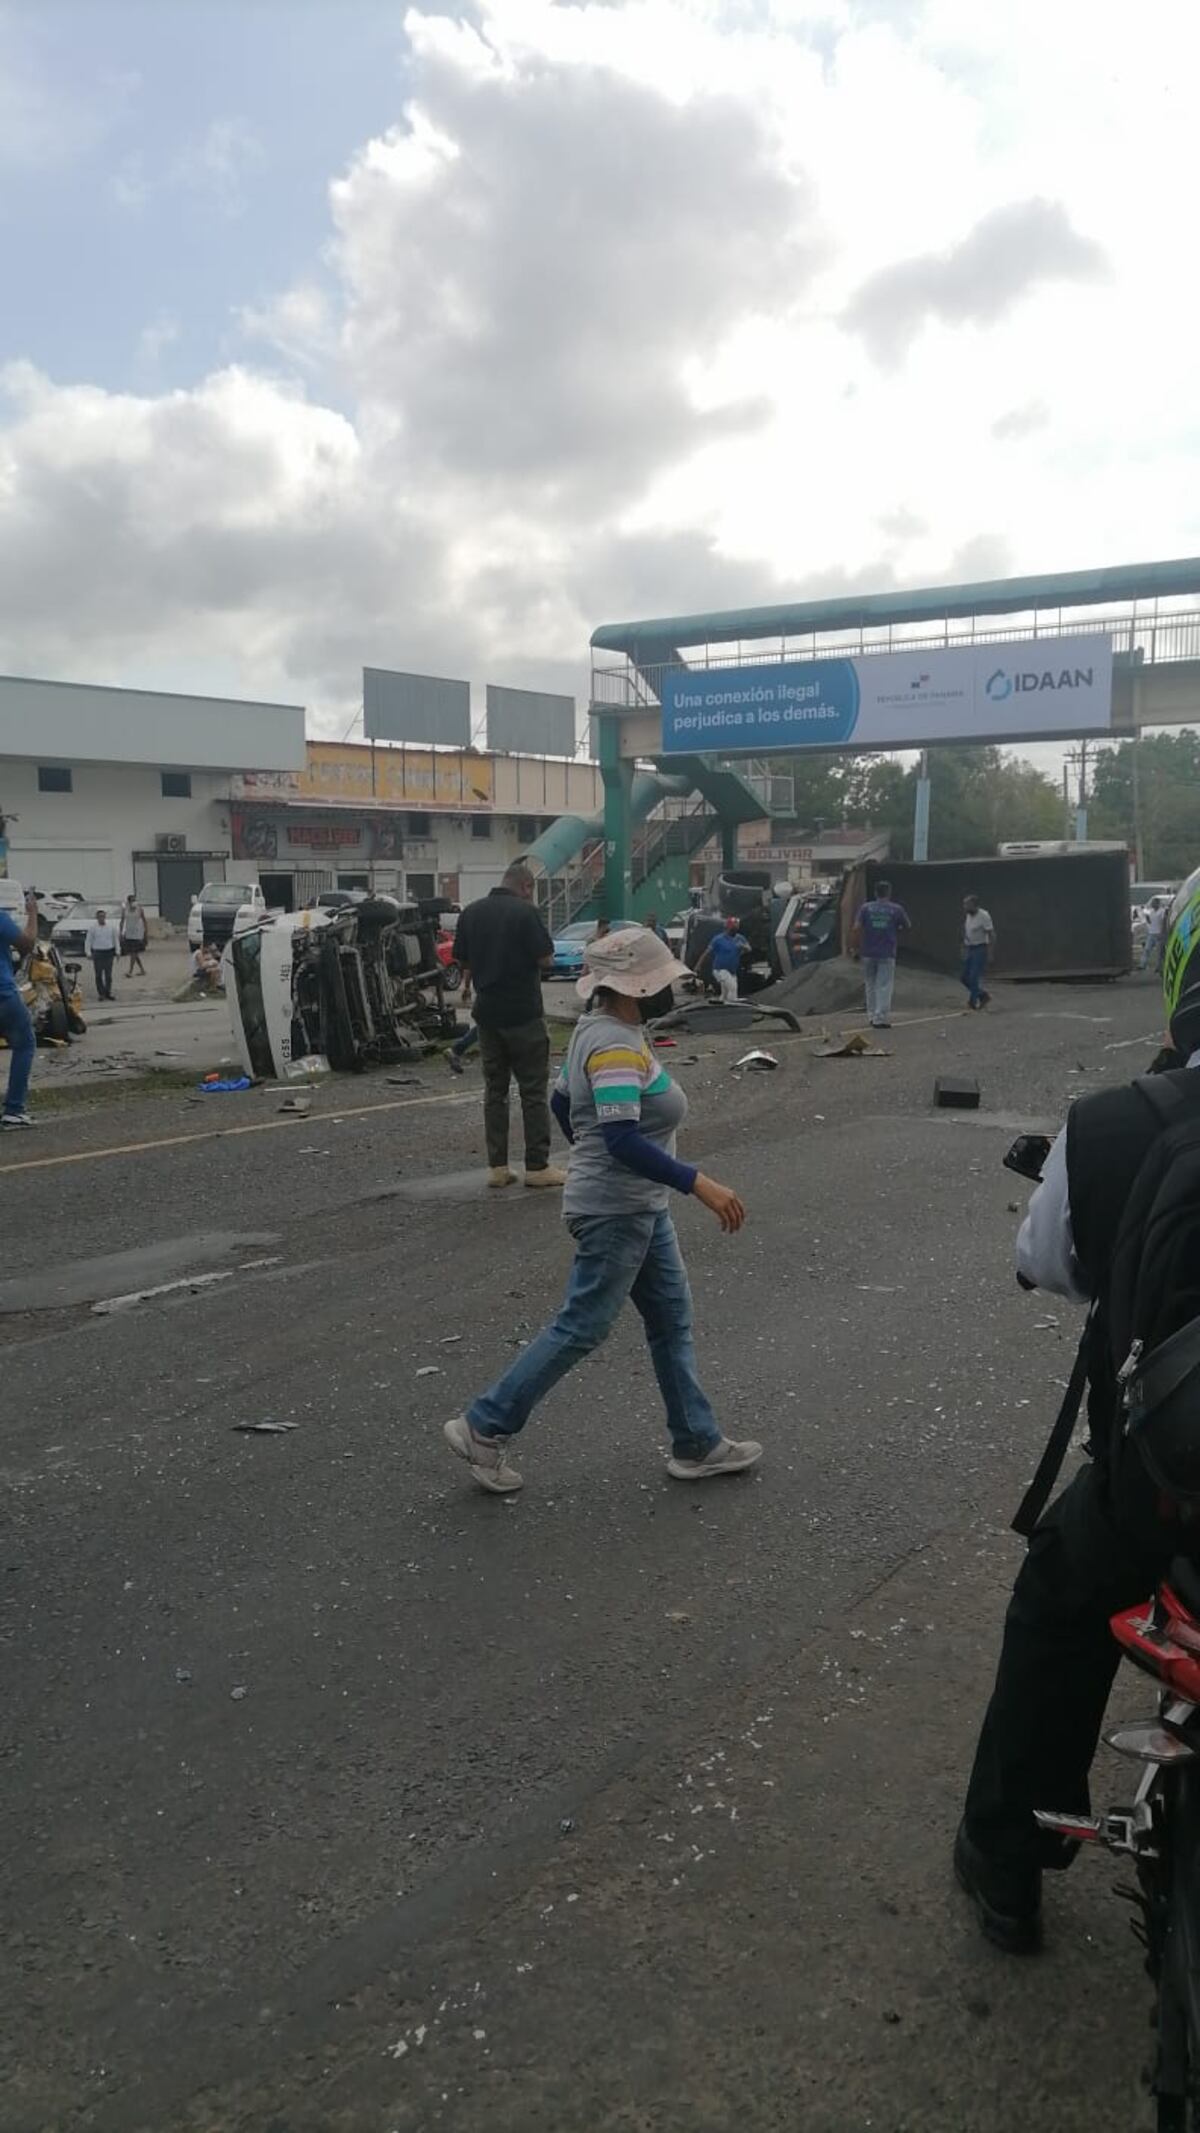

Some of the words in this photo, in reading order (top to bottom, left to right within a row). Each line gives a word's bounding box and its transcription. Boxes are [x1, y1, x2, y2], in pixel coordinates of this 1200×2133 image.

[1014, 667, 1093, 693] IDAAN
[673, 692, 702, 708] Una
[705, 685, 774, 706] conexión
[777, 681, 820, 702] ilegal
[673, 710, 743, 732] perjudica
[746, 713, 754, 724] a
[758, 707, 780, 723] los
[784, 702, 840, 721] demás.
[746, 847, 814, 860] BOLIVAR
